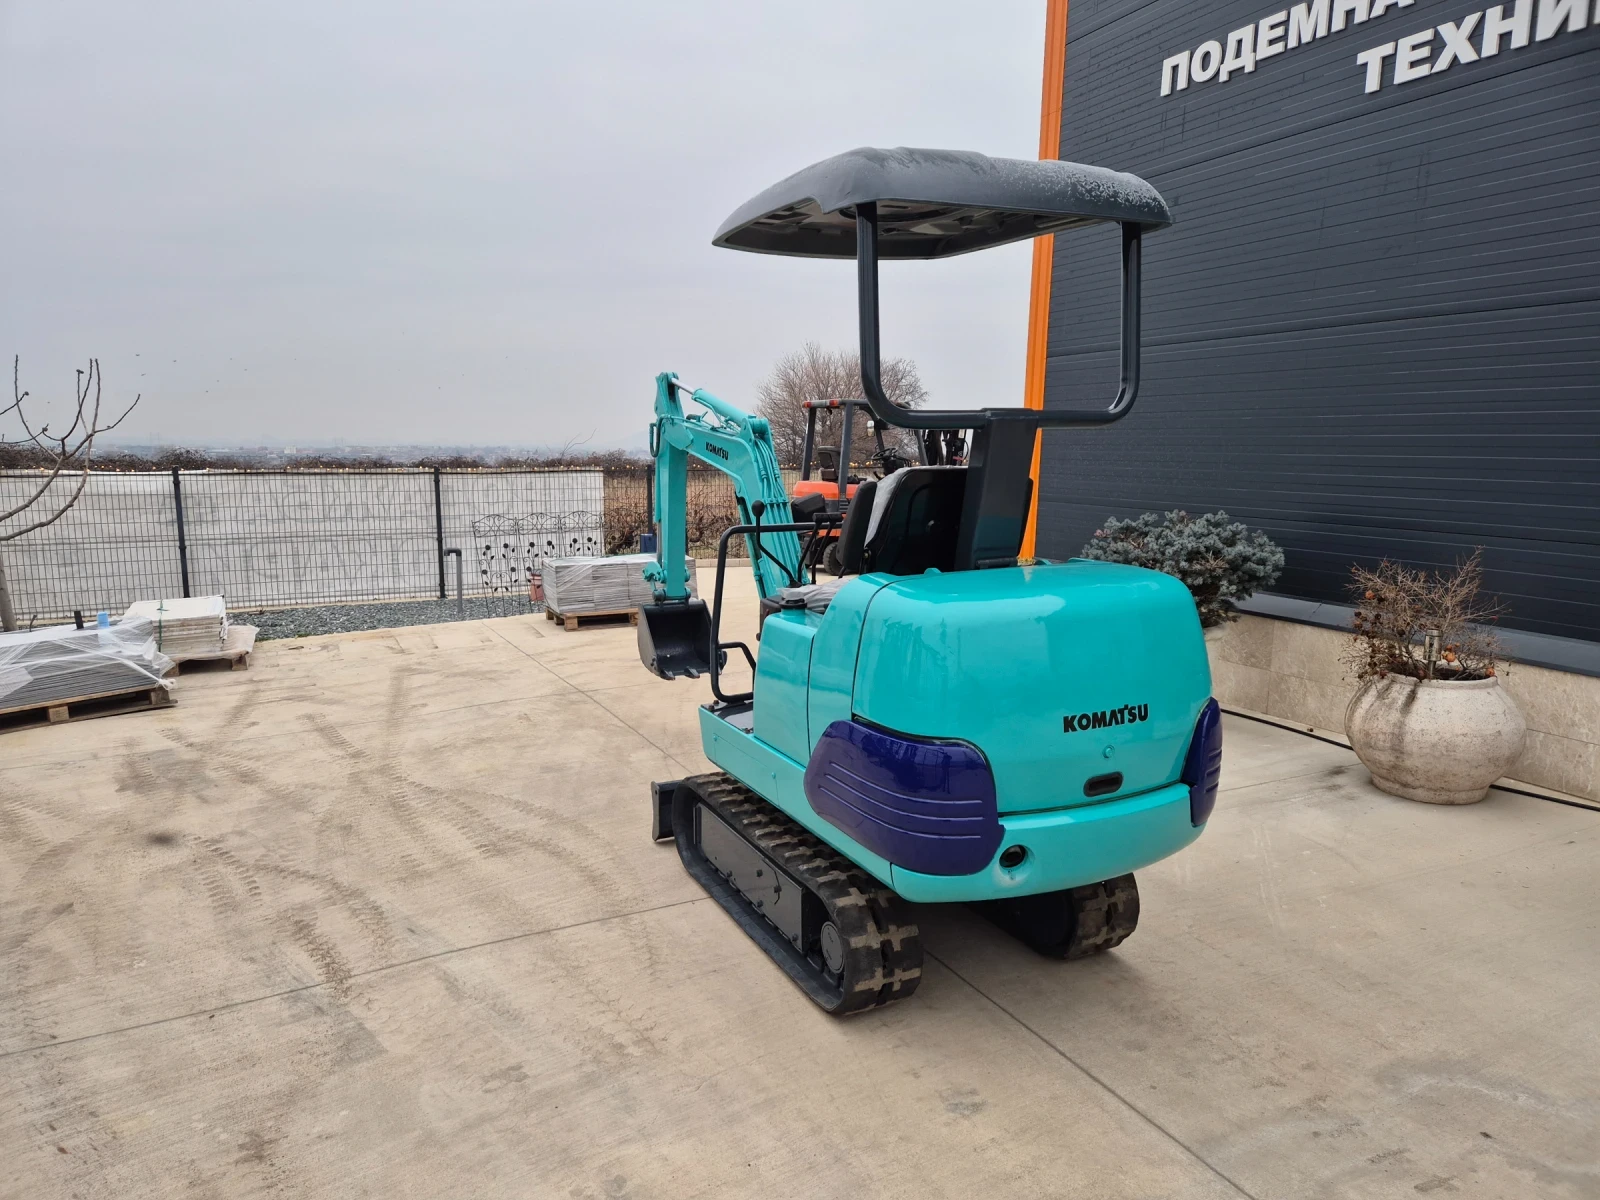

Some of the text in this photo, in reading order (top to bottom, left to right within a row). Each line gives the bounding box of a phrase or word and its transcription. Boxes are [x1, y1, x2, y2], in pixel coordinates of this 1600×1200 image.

[1160, 0, 1415, 96] ПОДЕМН
[1357, 0, 1600, 94] ТЕХНИ
[706, 442, 728, 460] KOMATSU
[1063, 703, 1149, 733] KOMATSU
